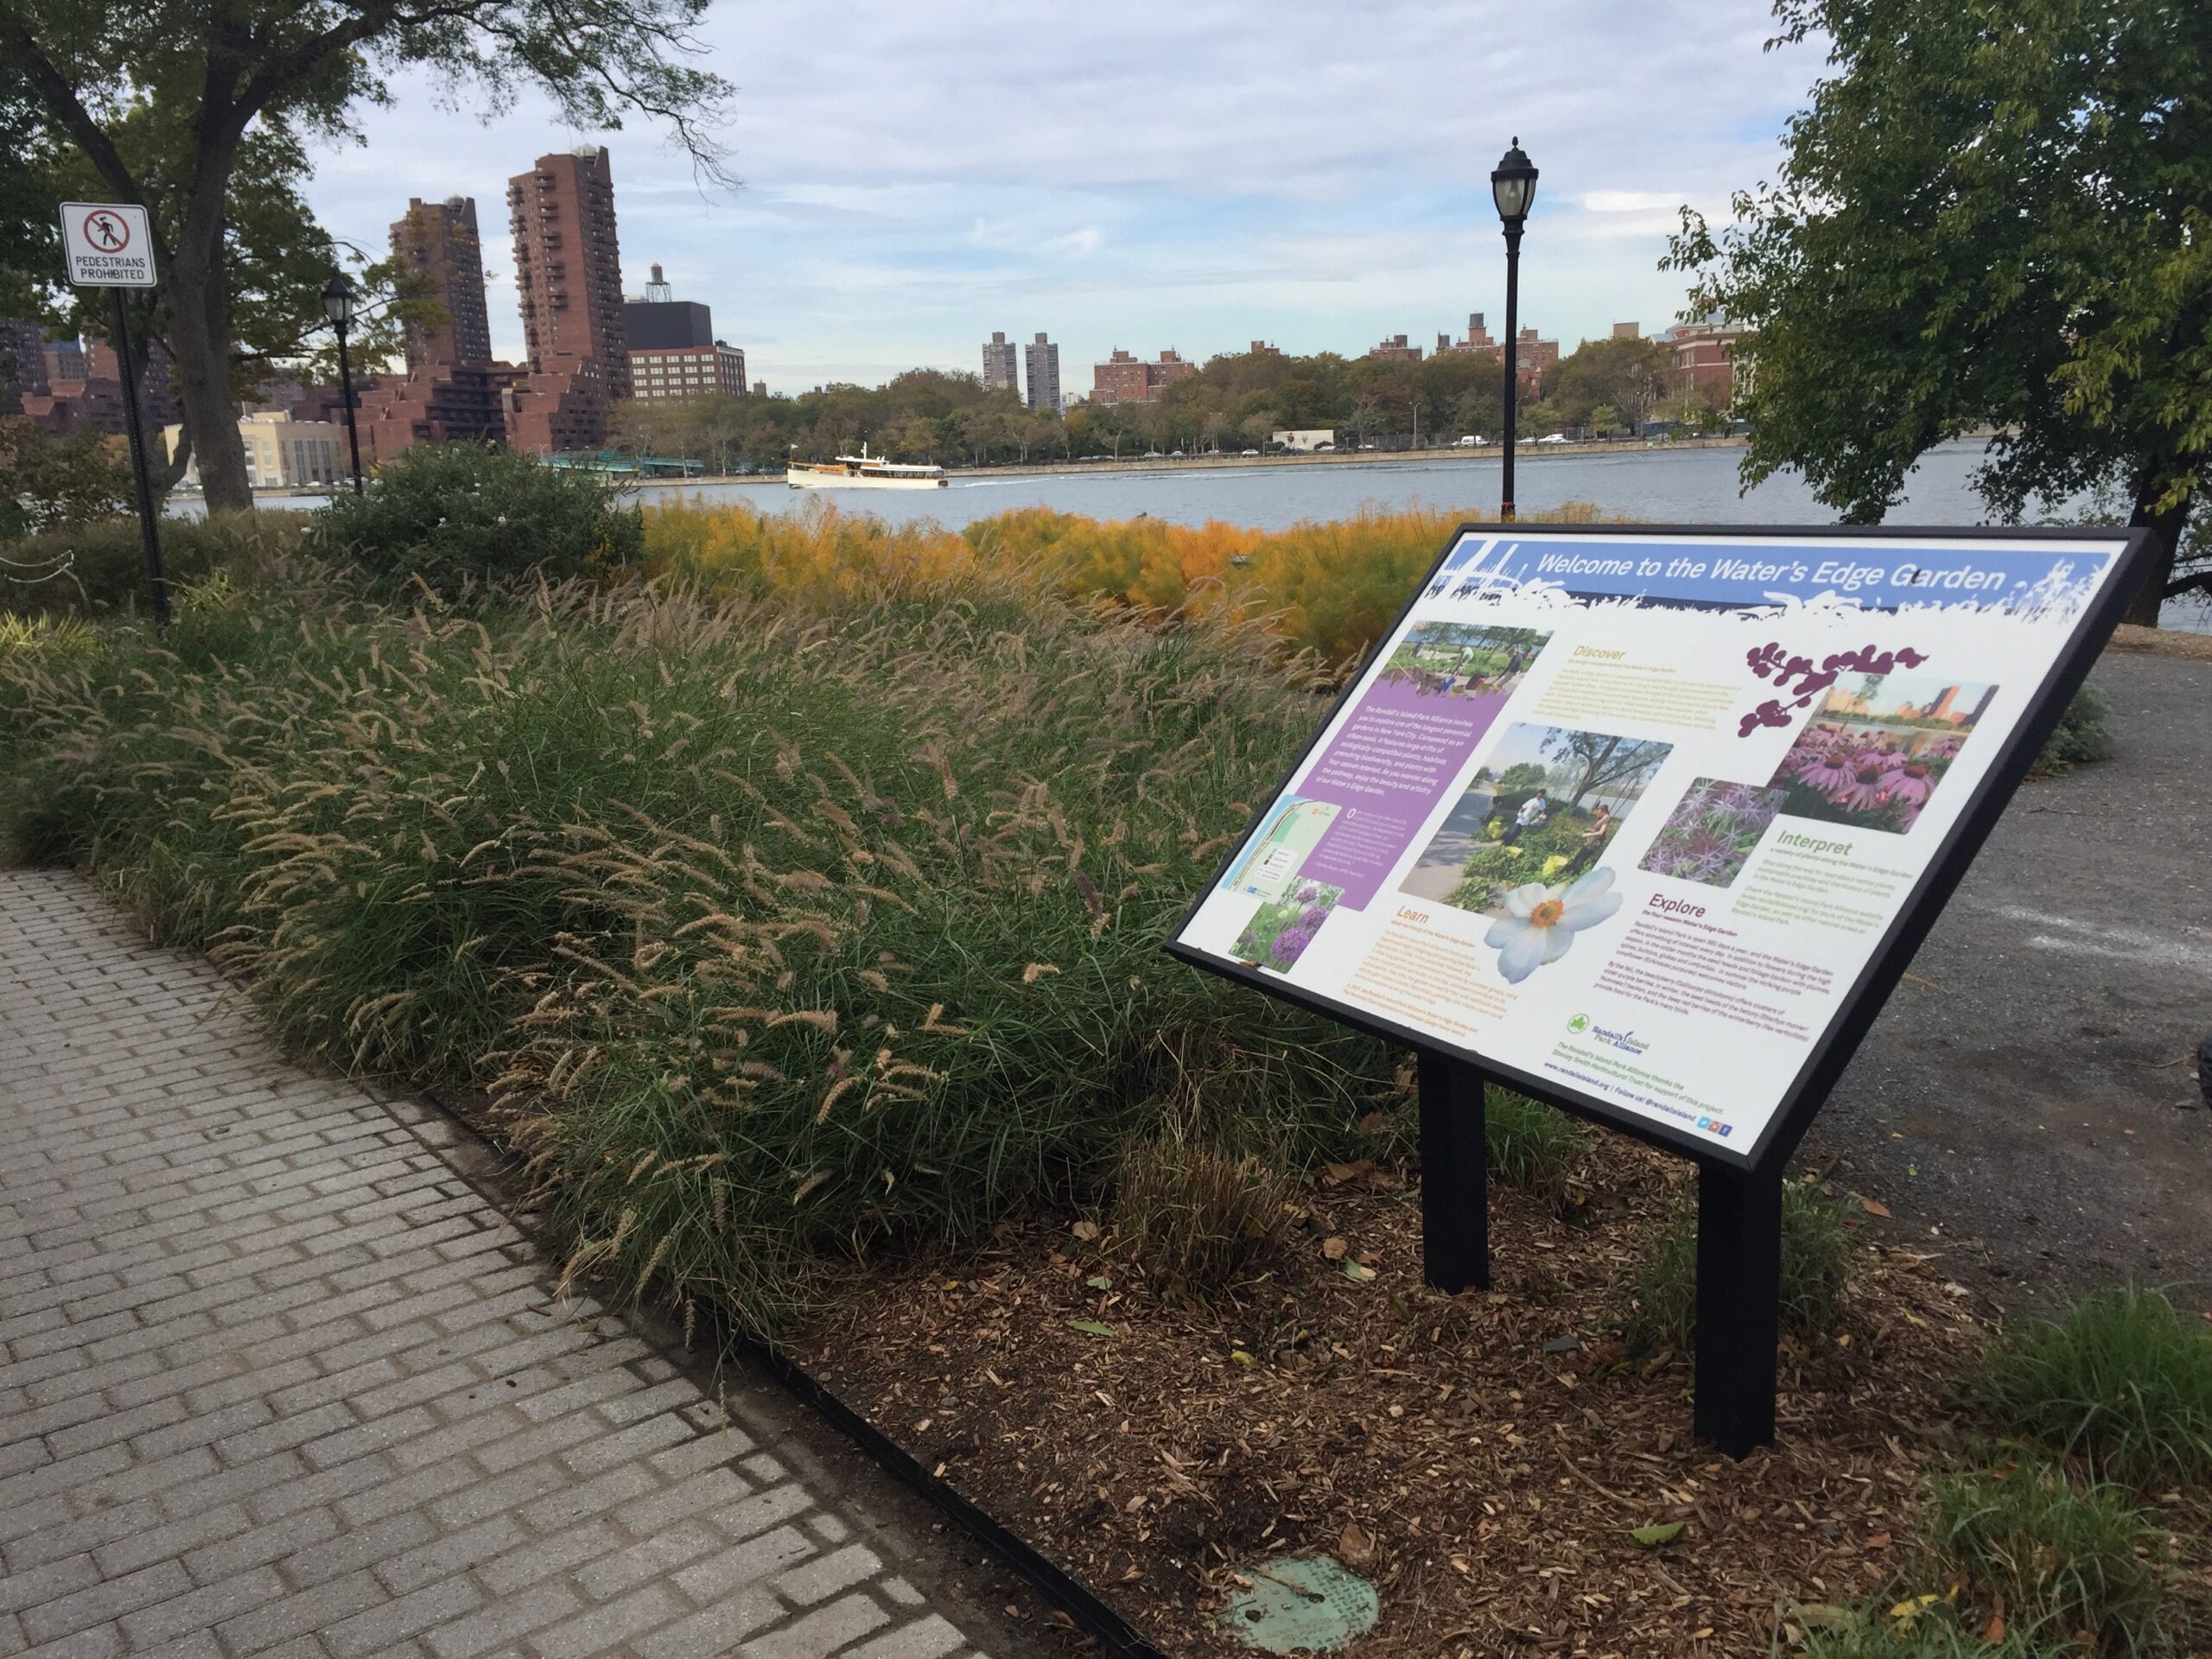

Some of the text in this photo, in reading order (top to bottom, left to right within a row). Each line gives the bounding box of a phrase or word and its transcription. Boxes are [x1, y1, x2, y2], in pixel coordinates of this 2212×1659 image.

[76, 256, 145, 268] PEDESTRIANS
[81, 268, 144, 280] PROHIBITED
[1536, 554, 2006, 591] Welcome to the Water's Edge Garden
[1571, 645, 1627, 660] Discover
[1775, 830, 1853, 856] Interpret
[1648, 893, 1706, 917] Explore
[1395, 906, 1429, 924] Learn
